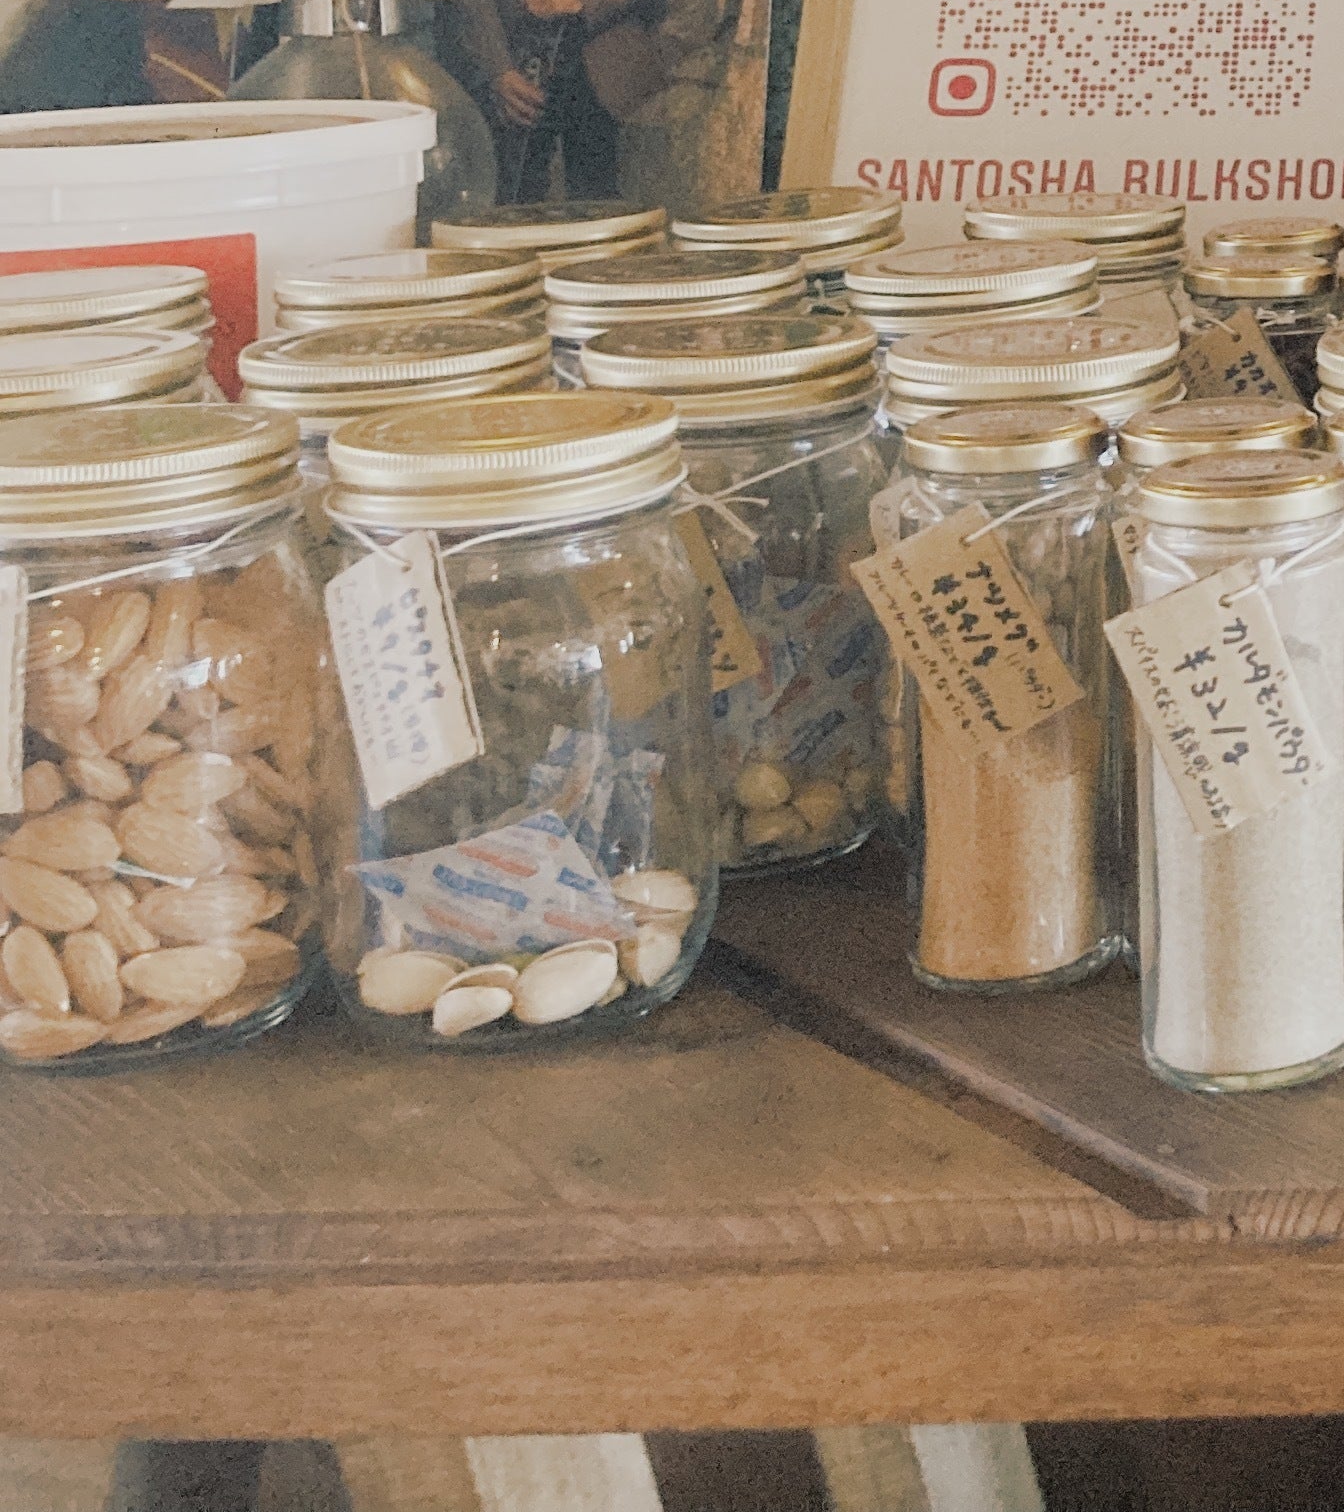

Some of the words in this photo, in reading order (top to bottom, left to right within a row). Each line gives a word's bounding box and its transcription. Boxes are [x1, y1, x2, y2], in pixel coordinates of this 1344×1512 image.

[856, 158, 1097, 202] SANTOSHA
[1173, 645, 1249, 766] ¥32/g
[1222, 616, 1324, 786] カルダモンパウダー
